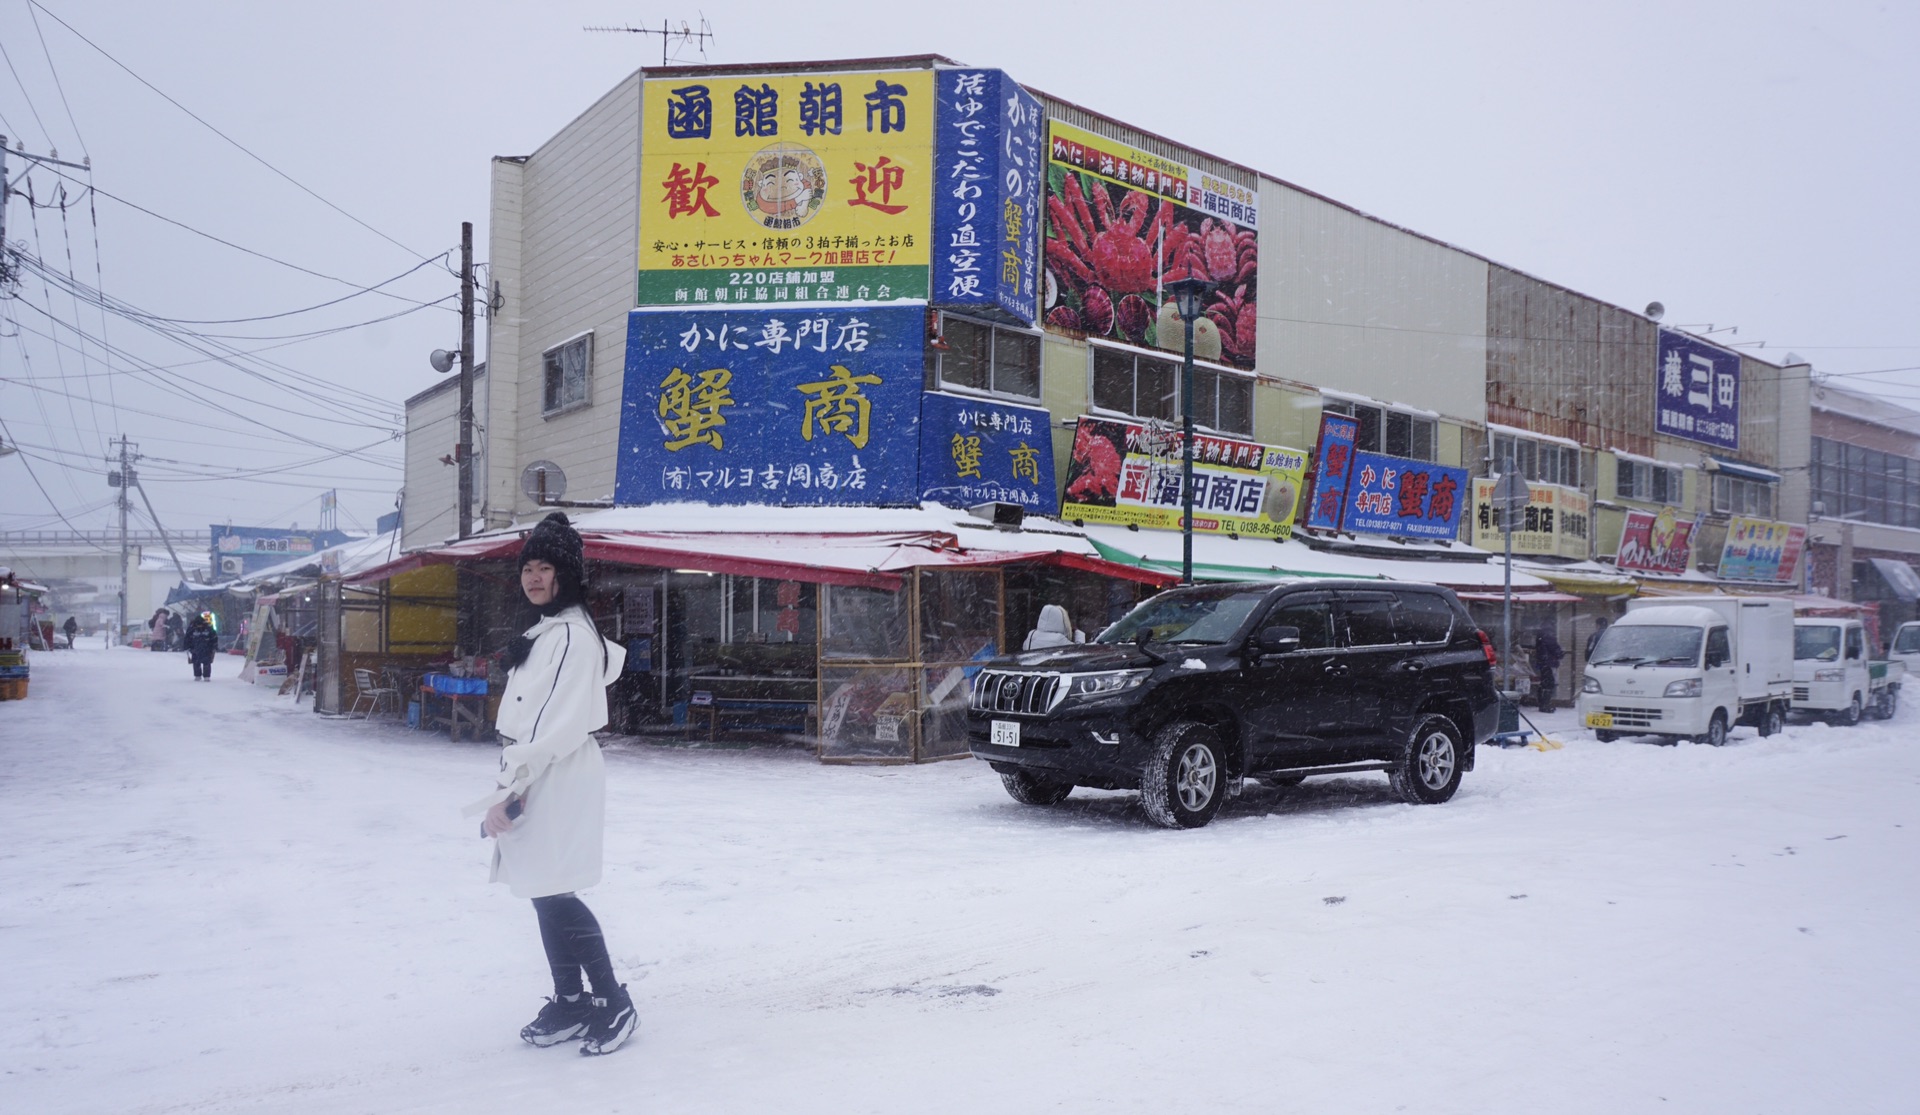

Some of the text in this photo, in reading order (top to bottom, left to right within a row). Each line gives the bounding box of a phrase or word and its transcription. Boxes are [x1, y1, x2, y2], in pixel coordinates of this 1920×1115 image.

[666, 79, 908, 139] 函館朝市
[949, 73, 987, 297] 活ゆでこだわり直空便
[1053, 140, 1186, 199] かに・海産物専門店
[660, 161, 721, 220] 歓
[847, 155, 909, 216] 迎
[1203, 191, 1257, 226] 福田商店
[674, 284, 891, 302] 函館朝市協同組合連合会
[729, 271, 836, 285] 220店舗加盟
[678, 318, 870, 353] かに専門店
[658, 364, 884, 453] 蟹商
[957, 408, 1033, 435] かに専門店
[951, 432, 1040, 484] 蟹商
[1265, 451, 1304, 470] 函館朝市
[661, 462, 867, 490] (有)マルヨ吉岡商店
[1318, 442, 1349, 524] 蟹商
[1360, 464, 1397, 490] かに
[1355, 491, 1393, 515] 専門店
[1397, 469, 1458, 523] 蟹商
[1221, 519, 1236, 531] TEL
[1240, 521, 1291, 536] 0138-26-4600
[997, 730, 1018, 745] 51-51
